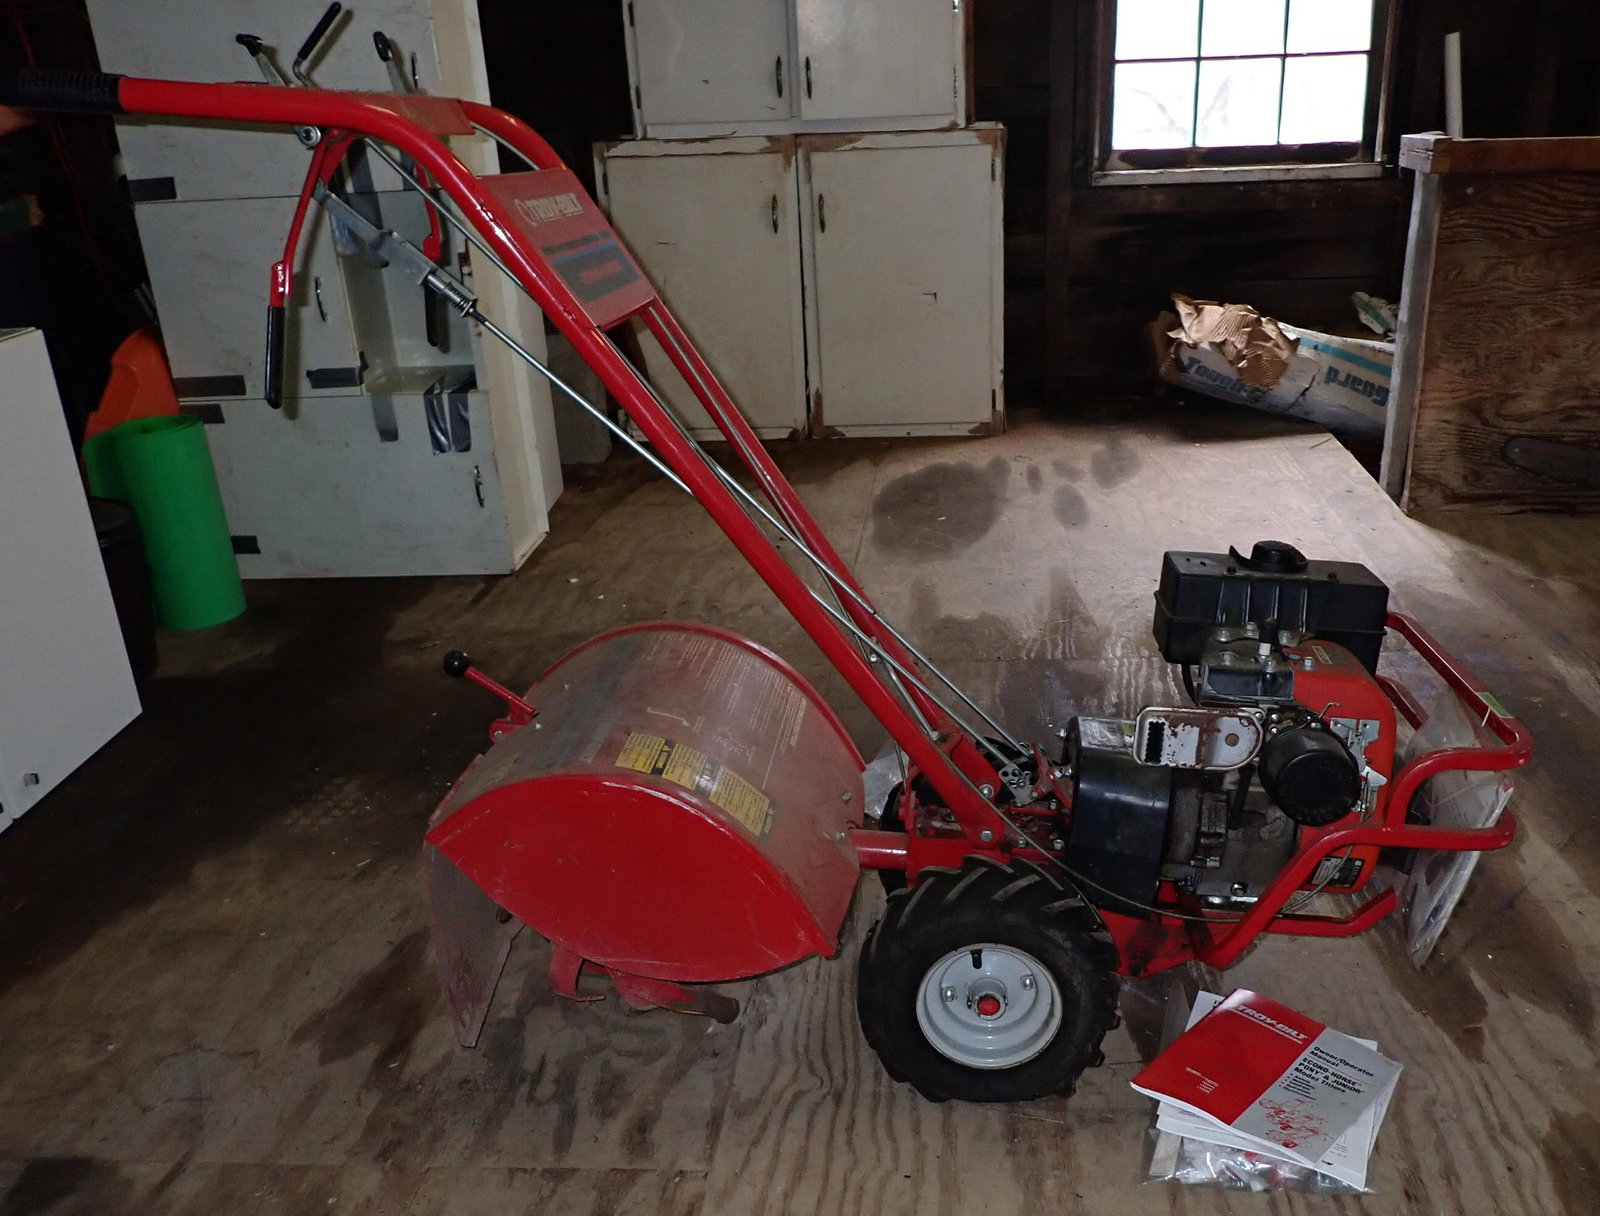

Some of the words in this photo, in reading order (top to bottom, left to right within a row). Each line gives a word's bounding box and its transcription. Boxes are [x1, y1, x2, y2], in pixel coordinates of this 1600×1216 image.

[1324, 365, 1391, 407] Guard
[1236, 1003, 1309, 1040] TROY-BILT
[1309, 1050, 1340, 1067] Manual
[1313, 1046, 1374, 1077] Owner/Operator
[1293, 1066, 1319, 1082] Model
[1321, 1079, 1346, 1094] Tillers
